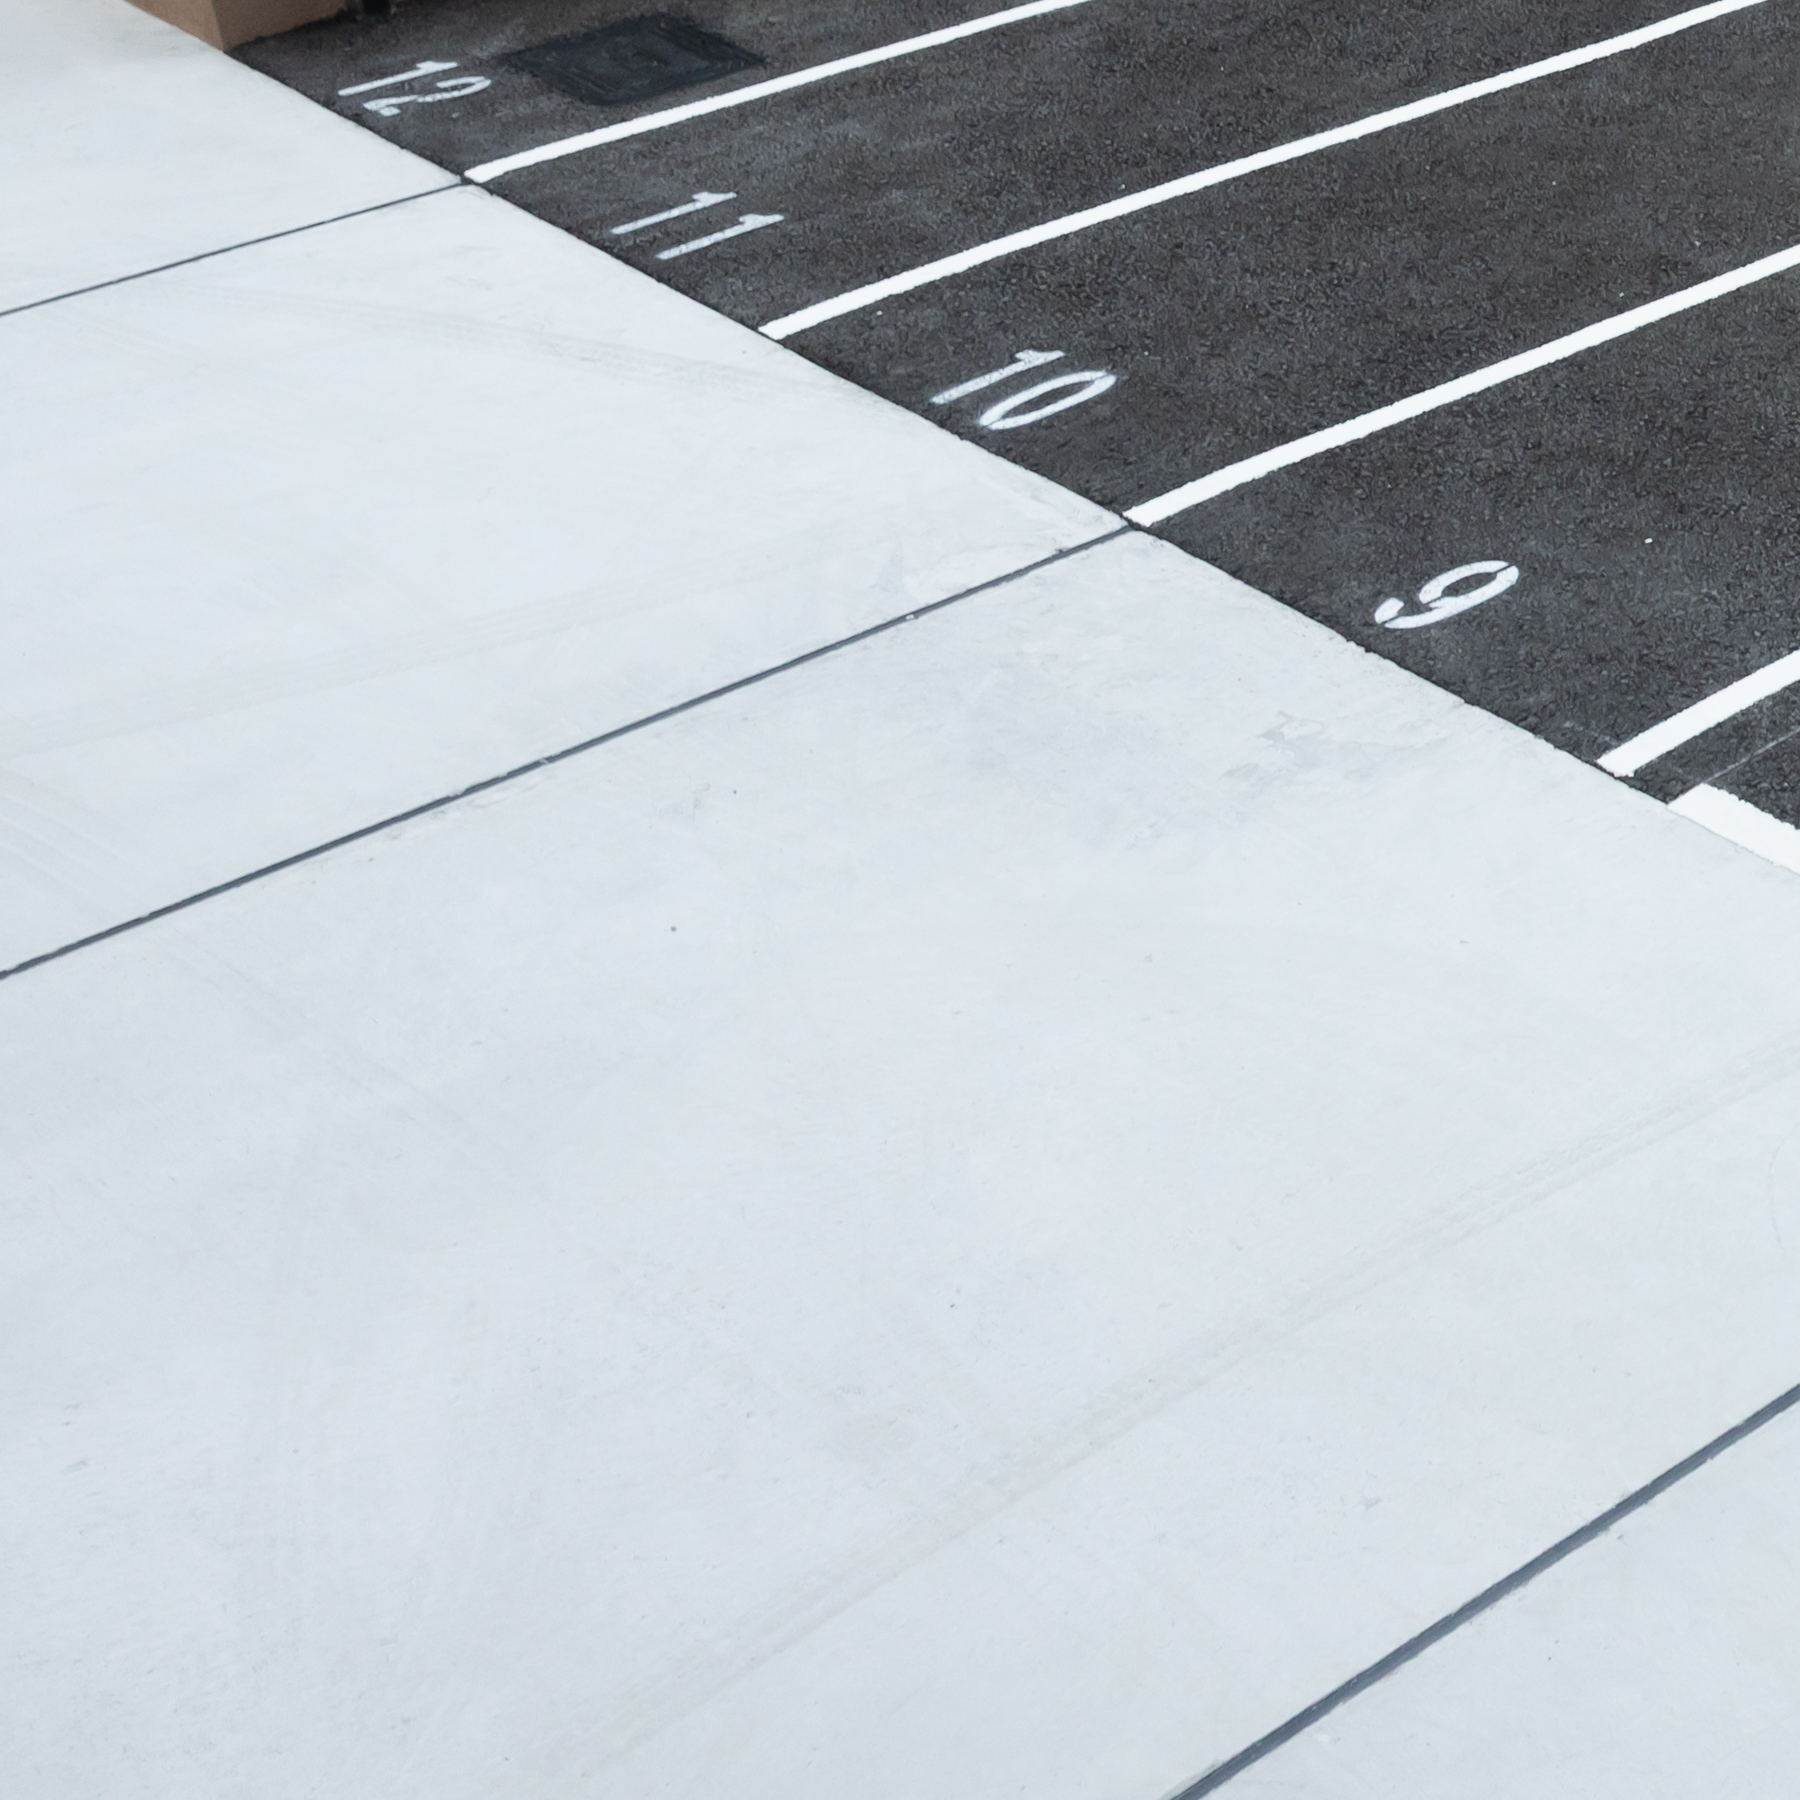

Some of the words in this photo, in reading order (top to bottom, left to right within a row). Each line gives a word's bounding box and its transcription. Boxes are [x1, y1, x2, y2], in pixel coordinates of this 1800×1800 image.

[337, 59, 492, 118] 12
[609, 190, 786, 261] 11
[929, 348, 1118, 431] 10
[1373, 559, 1520, 630] 9
